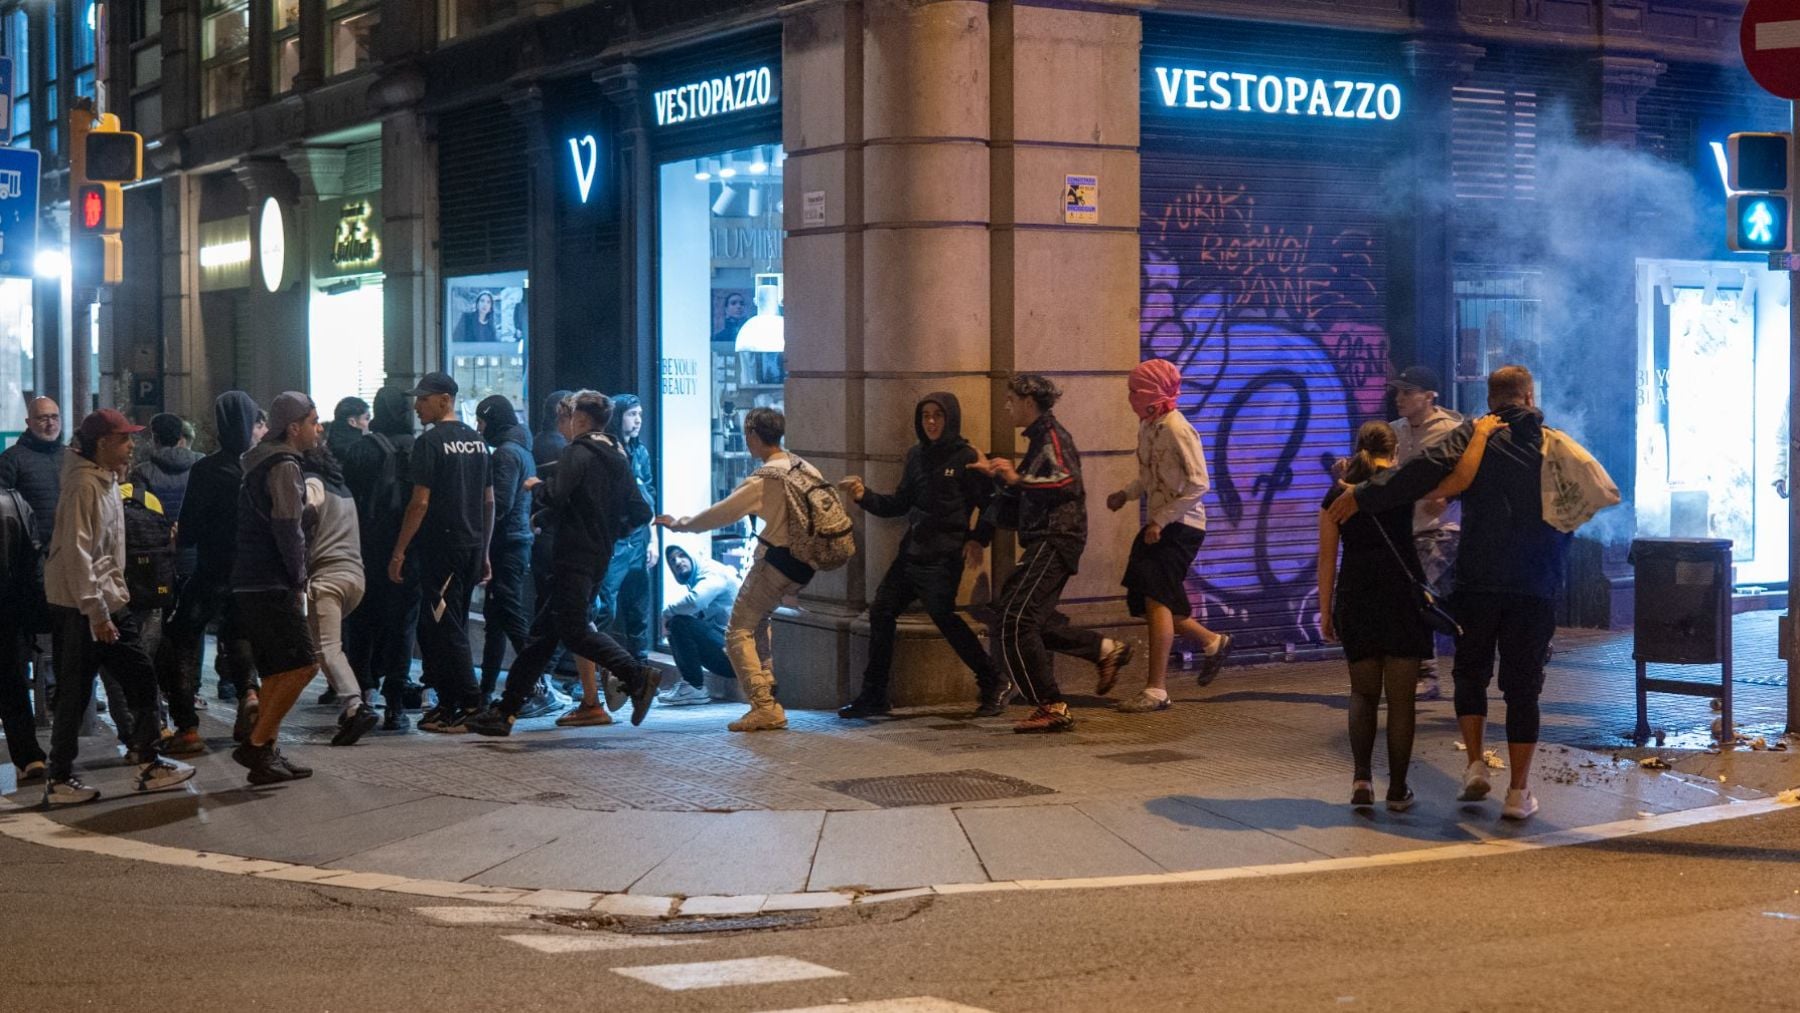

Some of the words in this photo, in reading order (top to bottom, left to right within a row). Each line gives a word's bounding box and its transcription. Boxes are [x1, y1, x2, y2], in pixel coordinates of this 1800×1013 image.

[654, 66, 771, 126] VESTOPAZZO
[1155, 67, 1401, 120] VESTOPAZZO
[140, 381, 153, 399] P
[663, 377, 697, 395] BEAUTY
